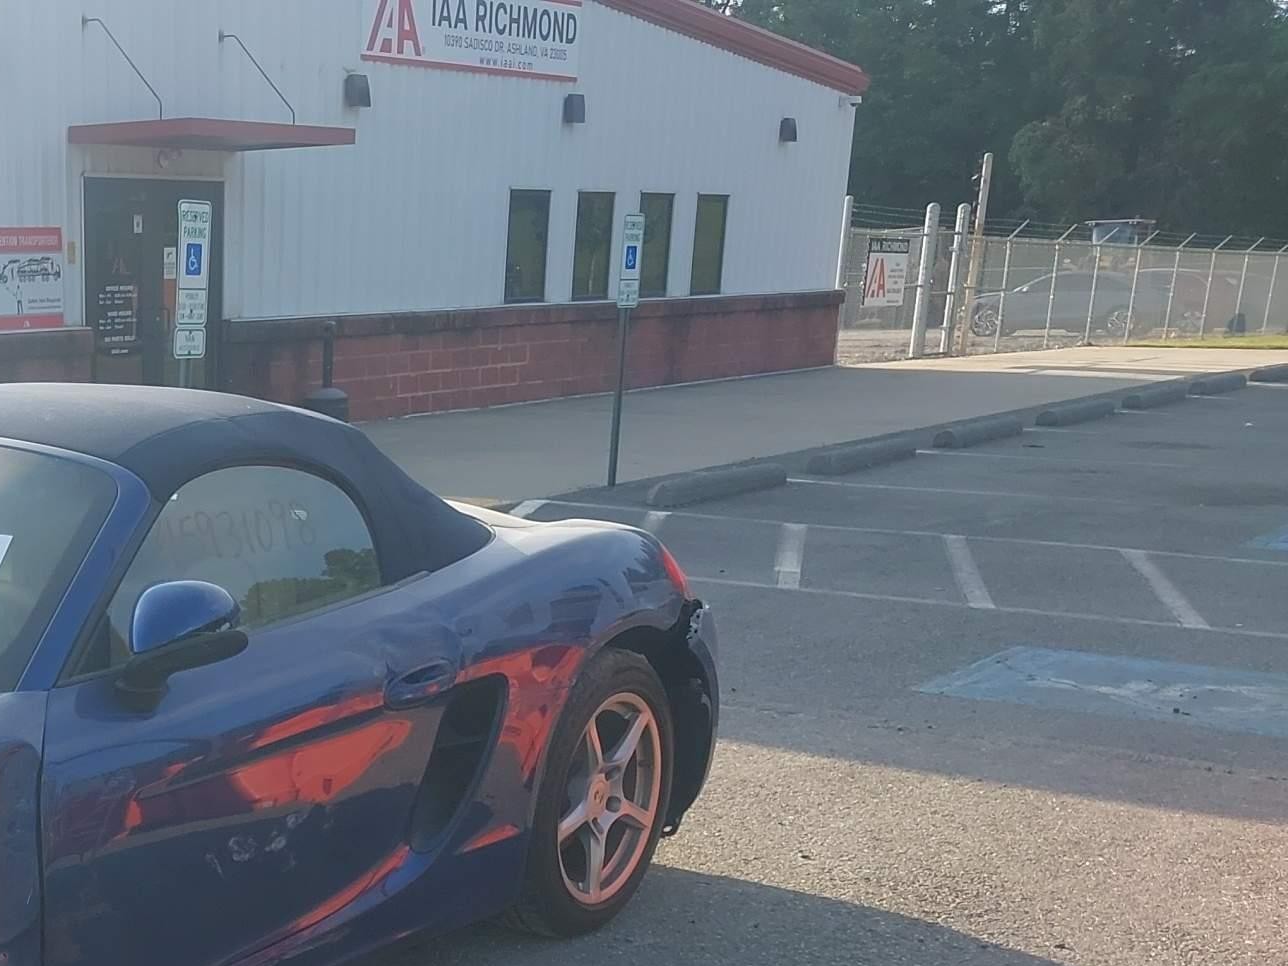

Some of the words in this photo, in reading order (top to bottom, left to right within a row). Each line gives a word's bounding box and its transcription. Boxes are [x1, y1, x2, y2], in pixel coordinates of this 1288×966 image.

[431, 0, 468, 30] IAA
[475, 0, 577, 44] RICHMOND
[463, 36, 493, 52] SADISCO
[181, 209, 209, 224] RESERVED
[183, 224, 207, 240] PARKING
